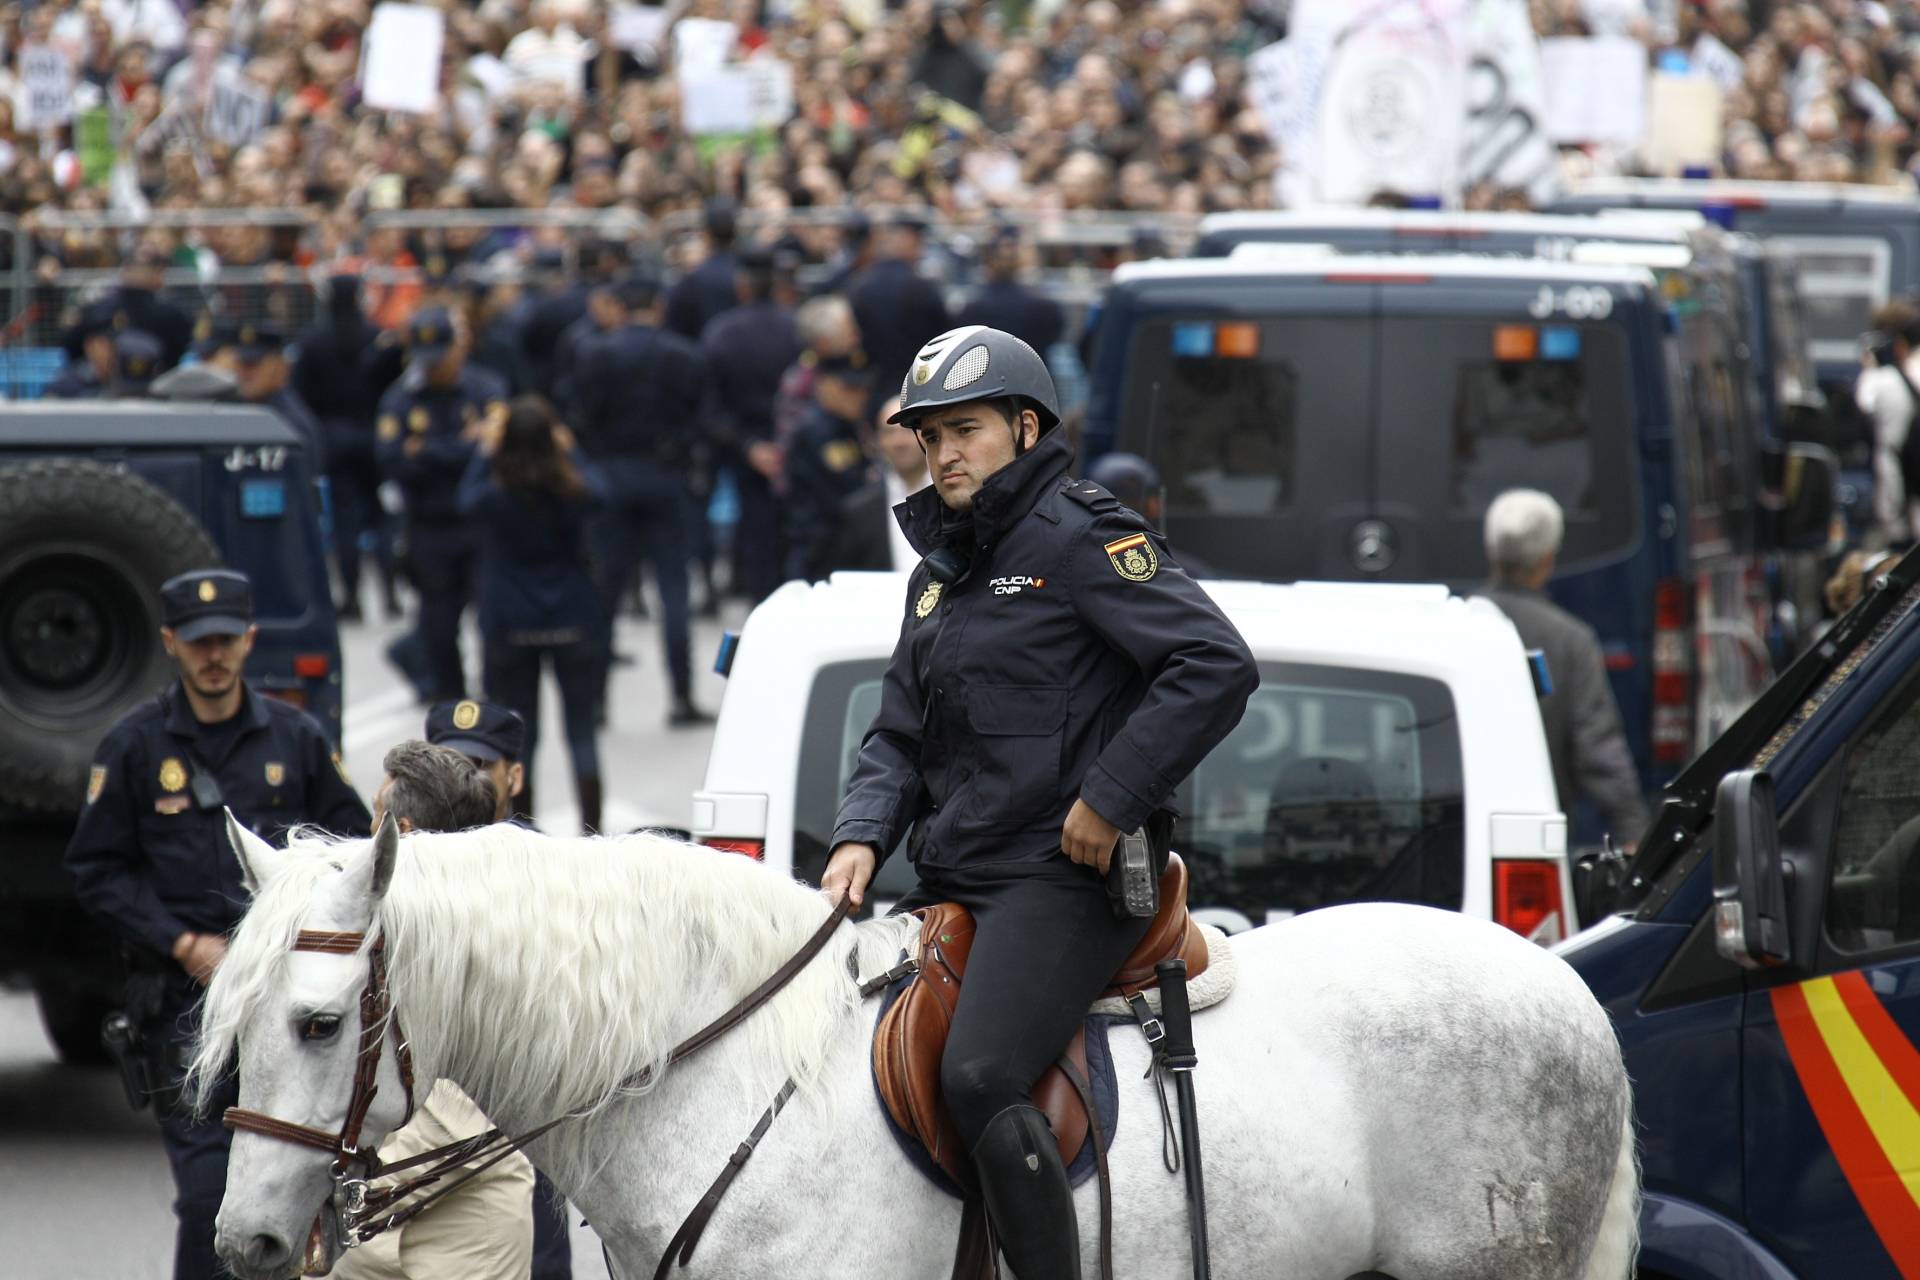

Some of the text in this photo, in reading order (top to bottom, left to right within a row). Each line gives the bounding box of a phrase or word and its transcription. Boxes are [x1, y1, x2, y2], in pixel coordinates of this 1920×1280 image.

[224, 446, 287, 472] J-17
[989, 576, 1034, 587] POLICIA
[994, 586, 1022, 595] CNP
